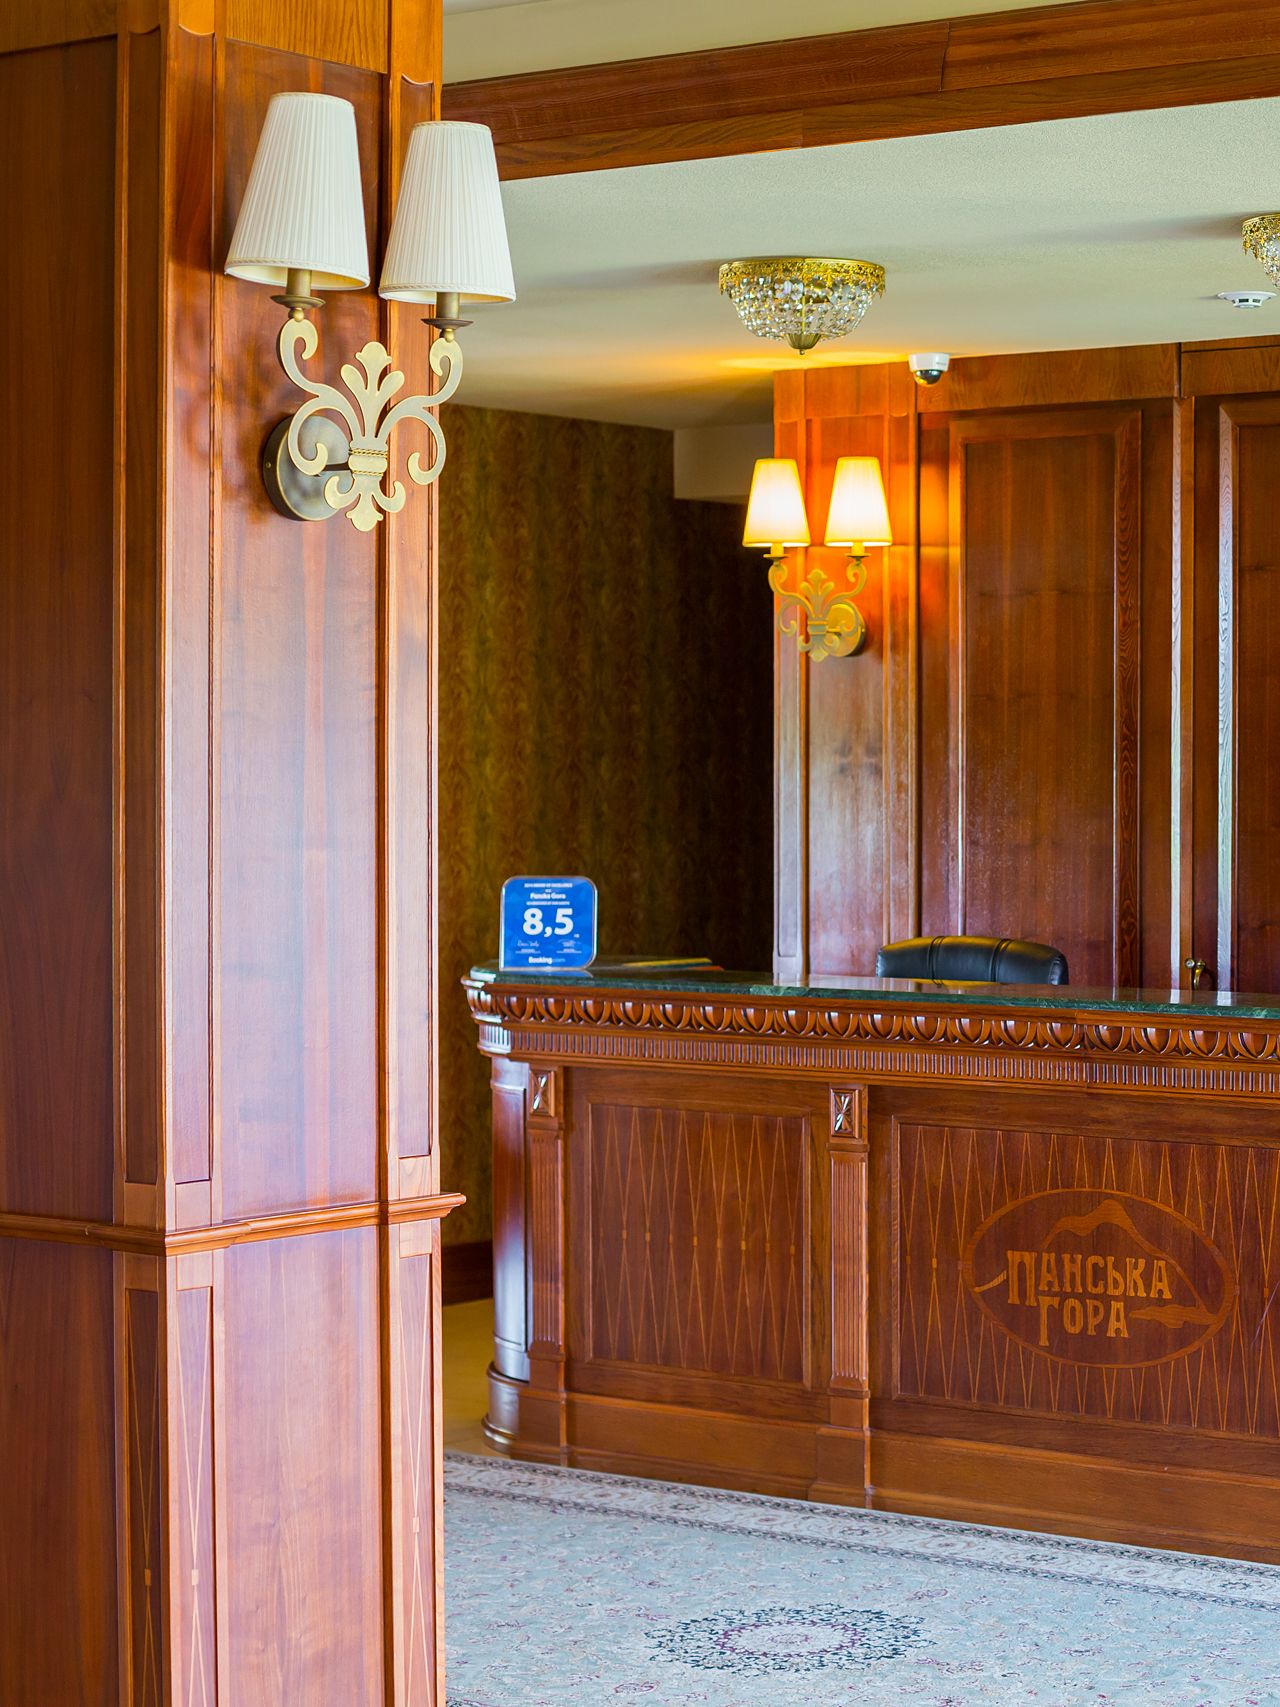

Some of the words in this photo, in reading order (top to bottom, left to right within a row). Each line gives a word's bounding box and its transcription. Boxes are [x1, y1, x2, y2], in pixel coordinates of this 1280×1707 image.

[522, 907, 574, 938] 8,5
[1006, 1250, 1173, 1307] ПАНСЬКА
[1037, 1295, 1129, 1347] ГОРА
